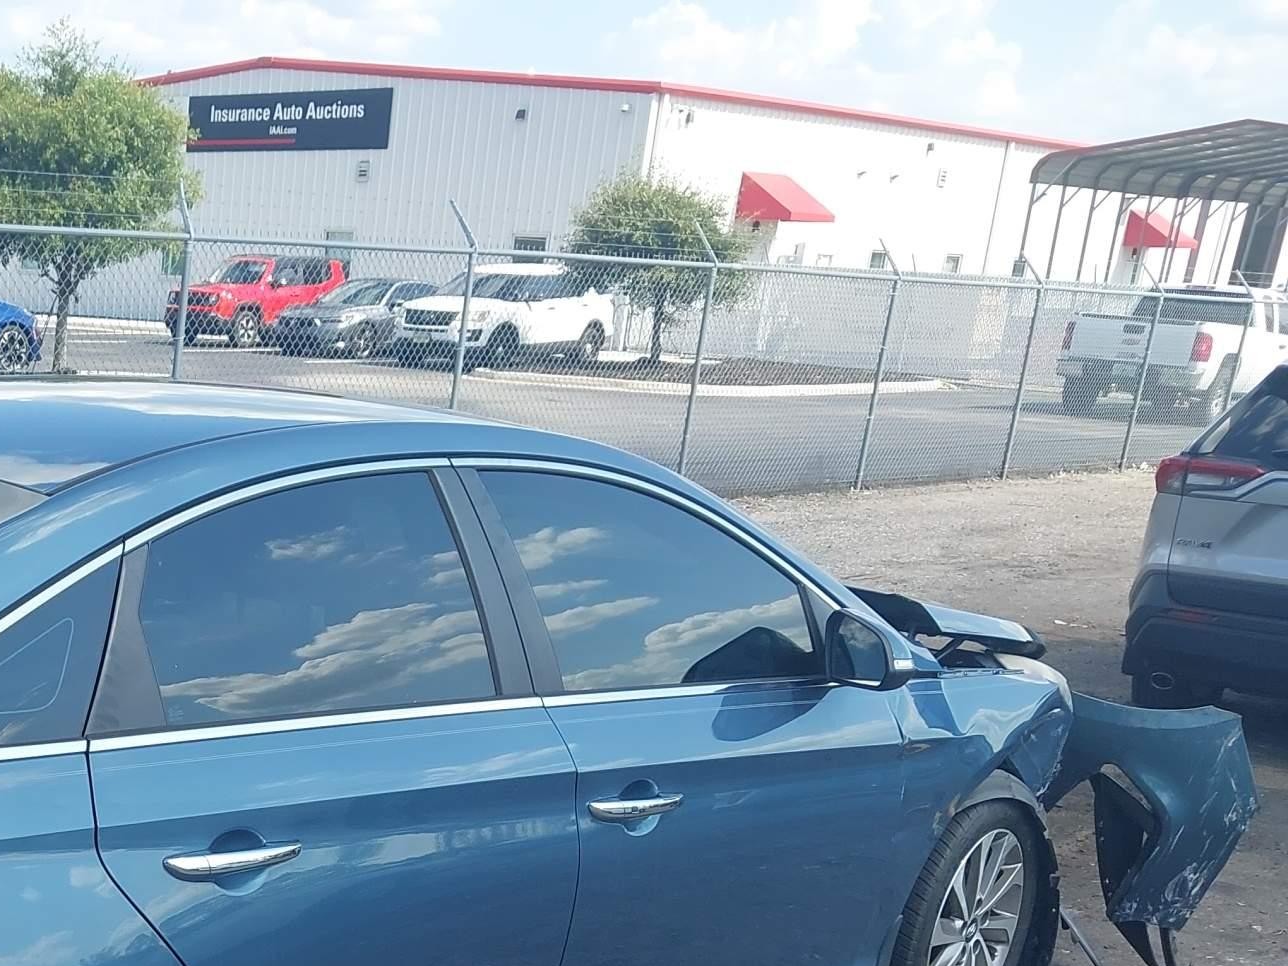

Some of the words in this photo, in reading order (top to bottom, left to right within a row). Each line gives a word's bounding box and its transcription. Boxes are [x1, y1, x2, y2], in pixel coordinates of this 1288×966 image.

[210, 104, 271, 123] Insurance
[273, 102, 303, 121] Auto
[305, 100, 365, 120] Auctions
